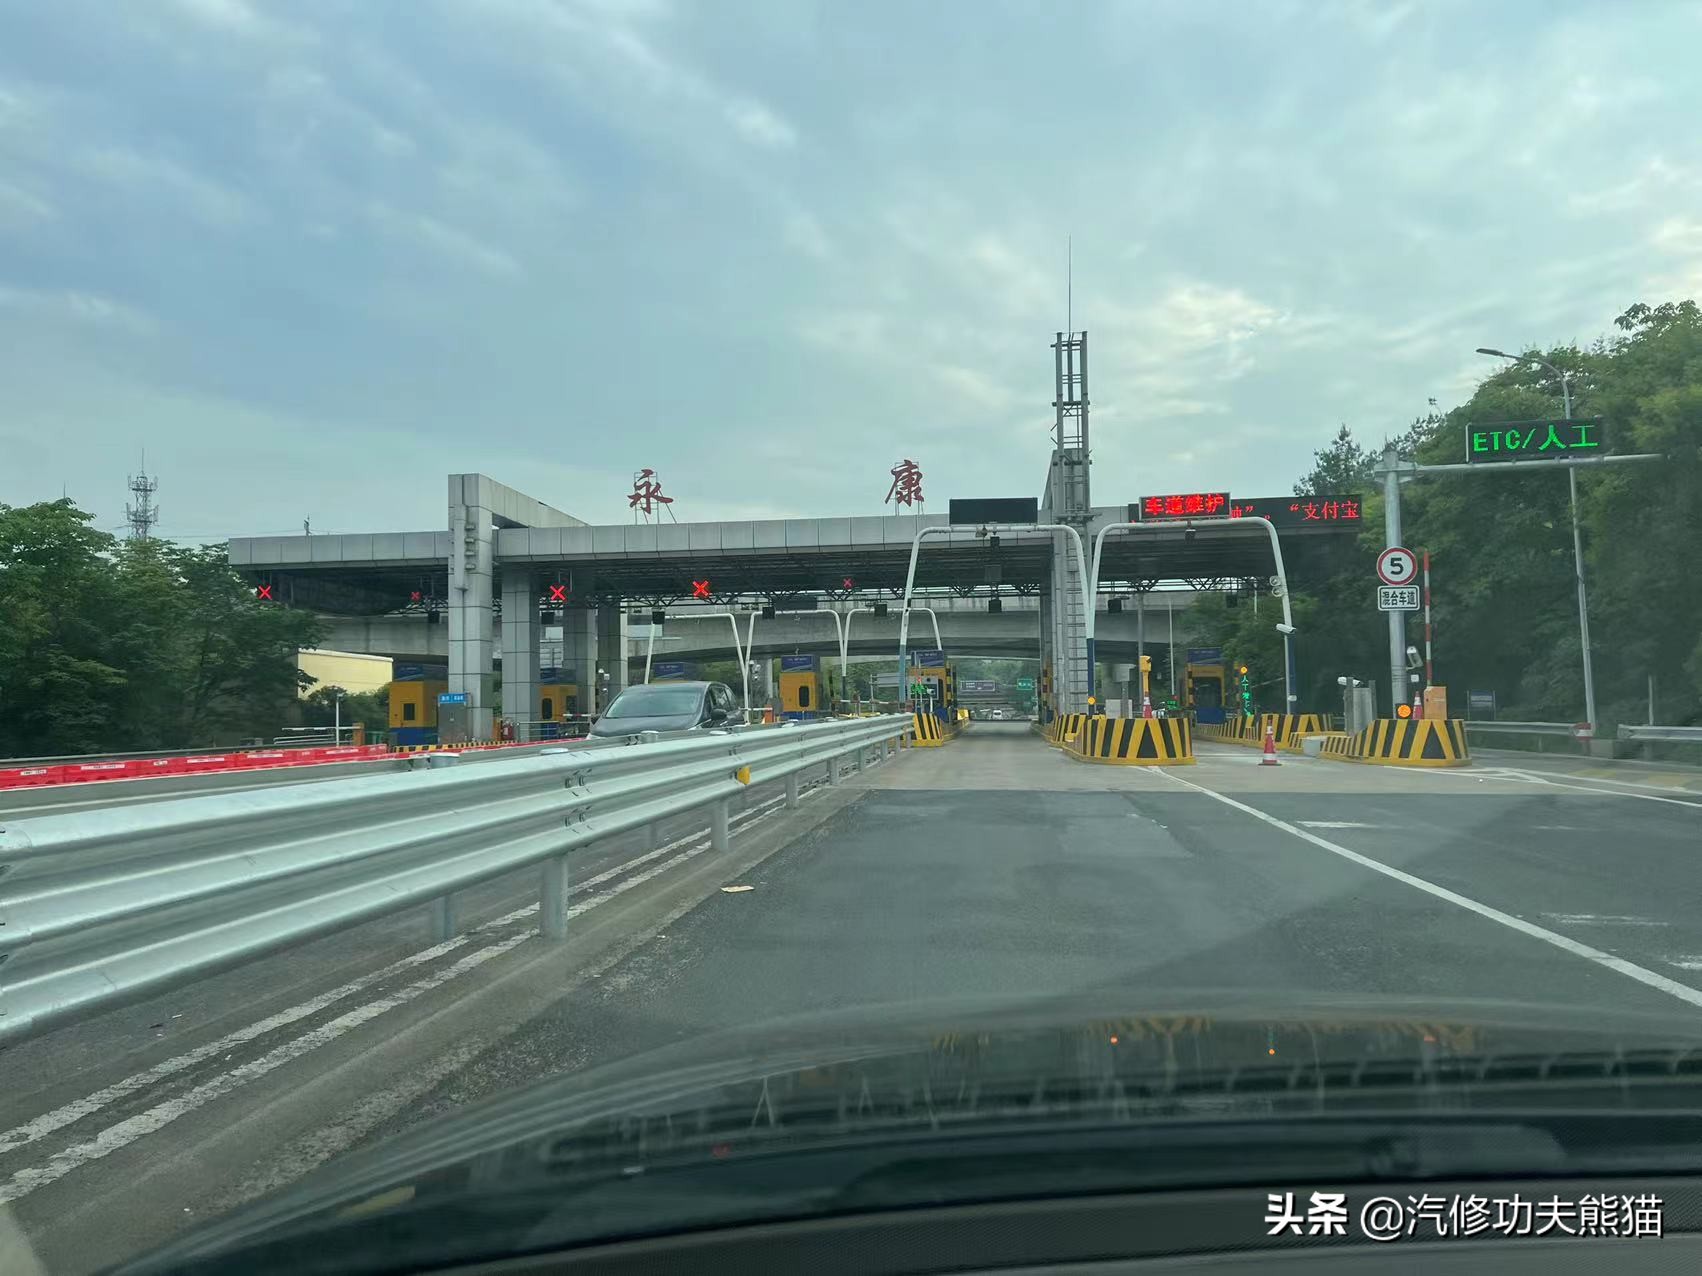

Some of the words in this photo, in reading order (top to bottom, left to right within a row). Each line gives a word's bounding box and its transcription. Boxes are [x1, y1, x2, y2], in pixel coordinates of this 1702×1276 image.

[1473, 424, 1600, 452] ETC/人工
[1144, 493, 1225, 516] 车道维护
[1390, 557, 1404, 576] 5
[1382, 590, 1416, 606] 混合车道
